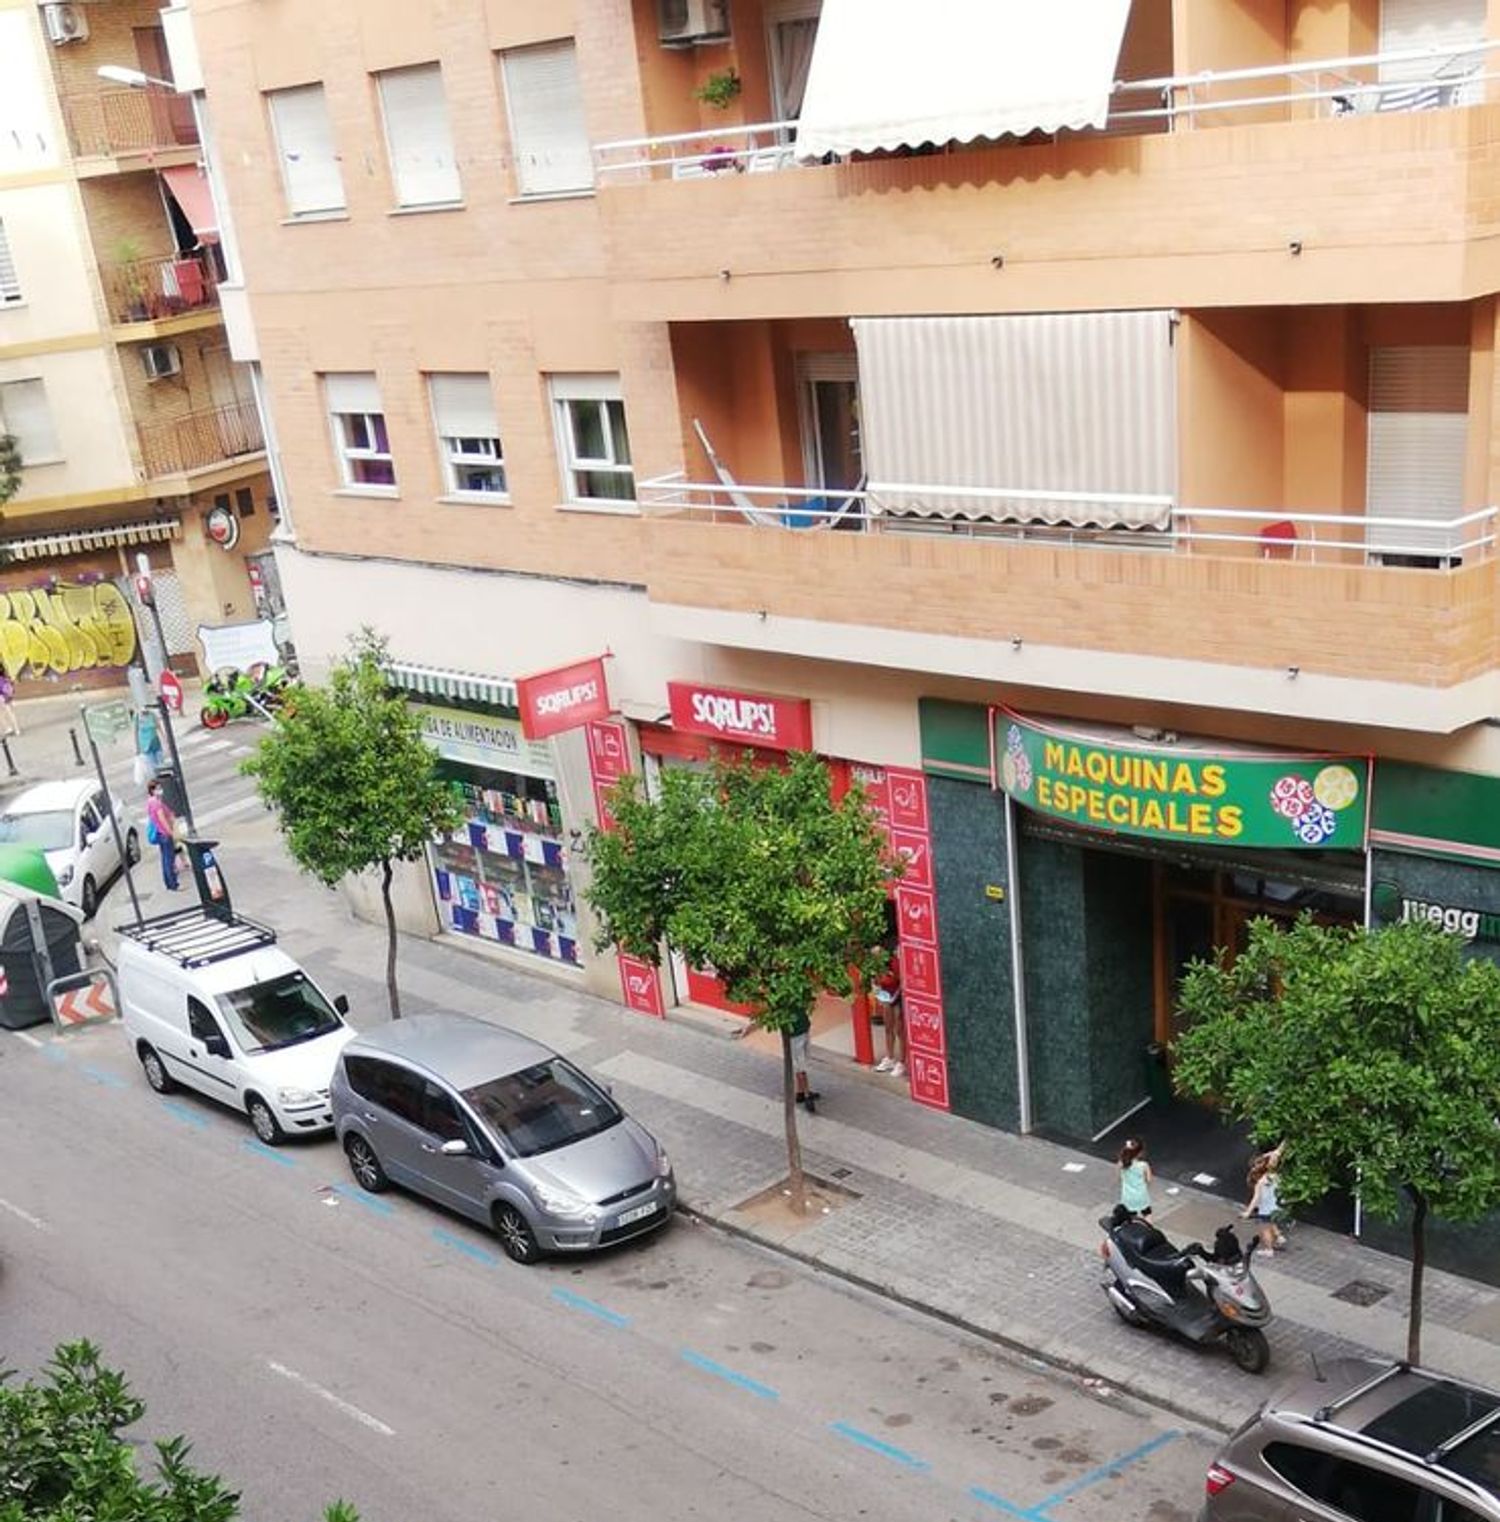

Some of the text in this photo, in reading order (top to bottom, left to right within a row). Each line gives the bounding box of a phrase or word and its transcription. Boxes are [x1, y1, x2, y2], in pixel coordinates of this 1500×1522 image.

[536, 681, 598, 716] SQRUPS!
[691, 692, 776, 735] SQRUPS!
[1045, 741, 1227, 797] MAQUINAS
[1036, 776, 1243, 837] ESPECIALES
